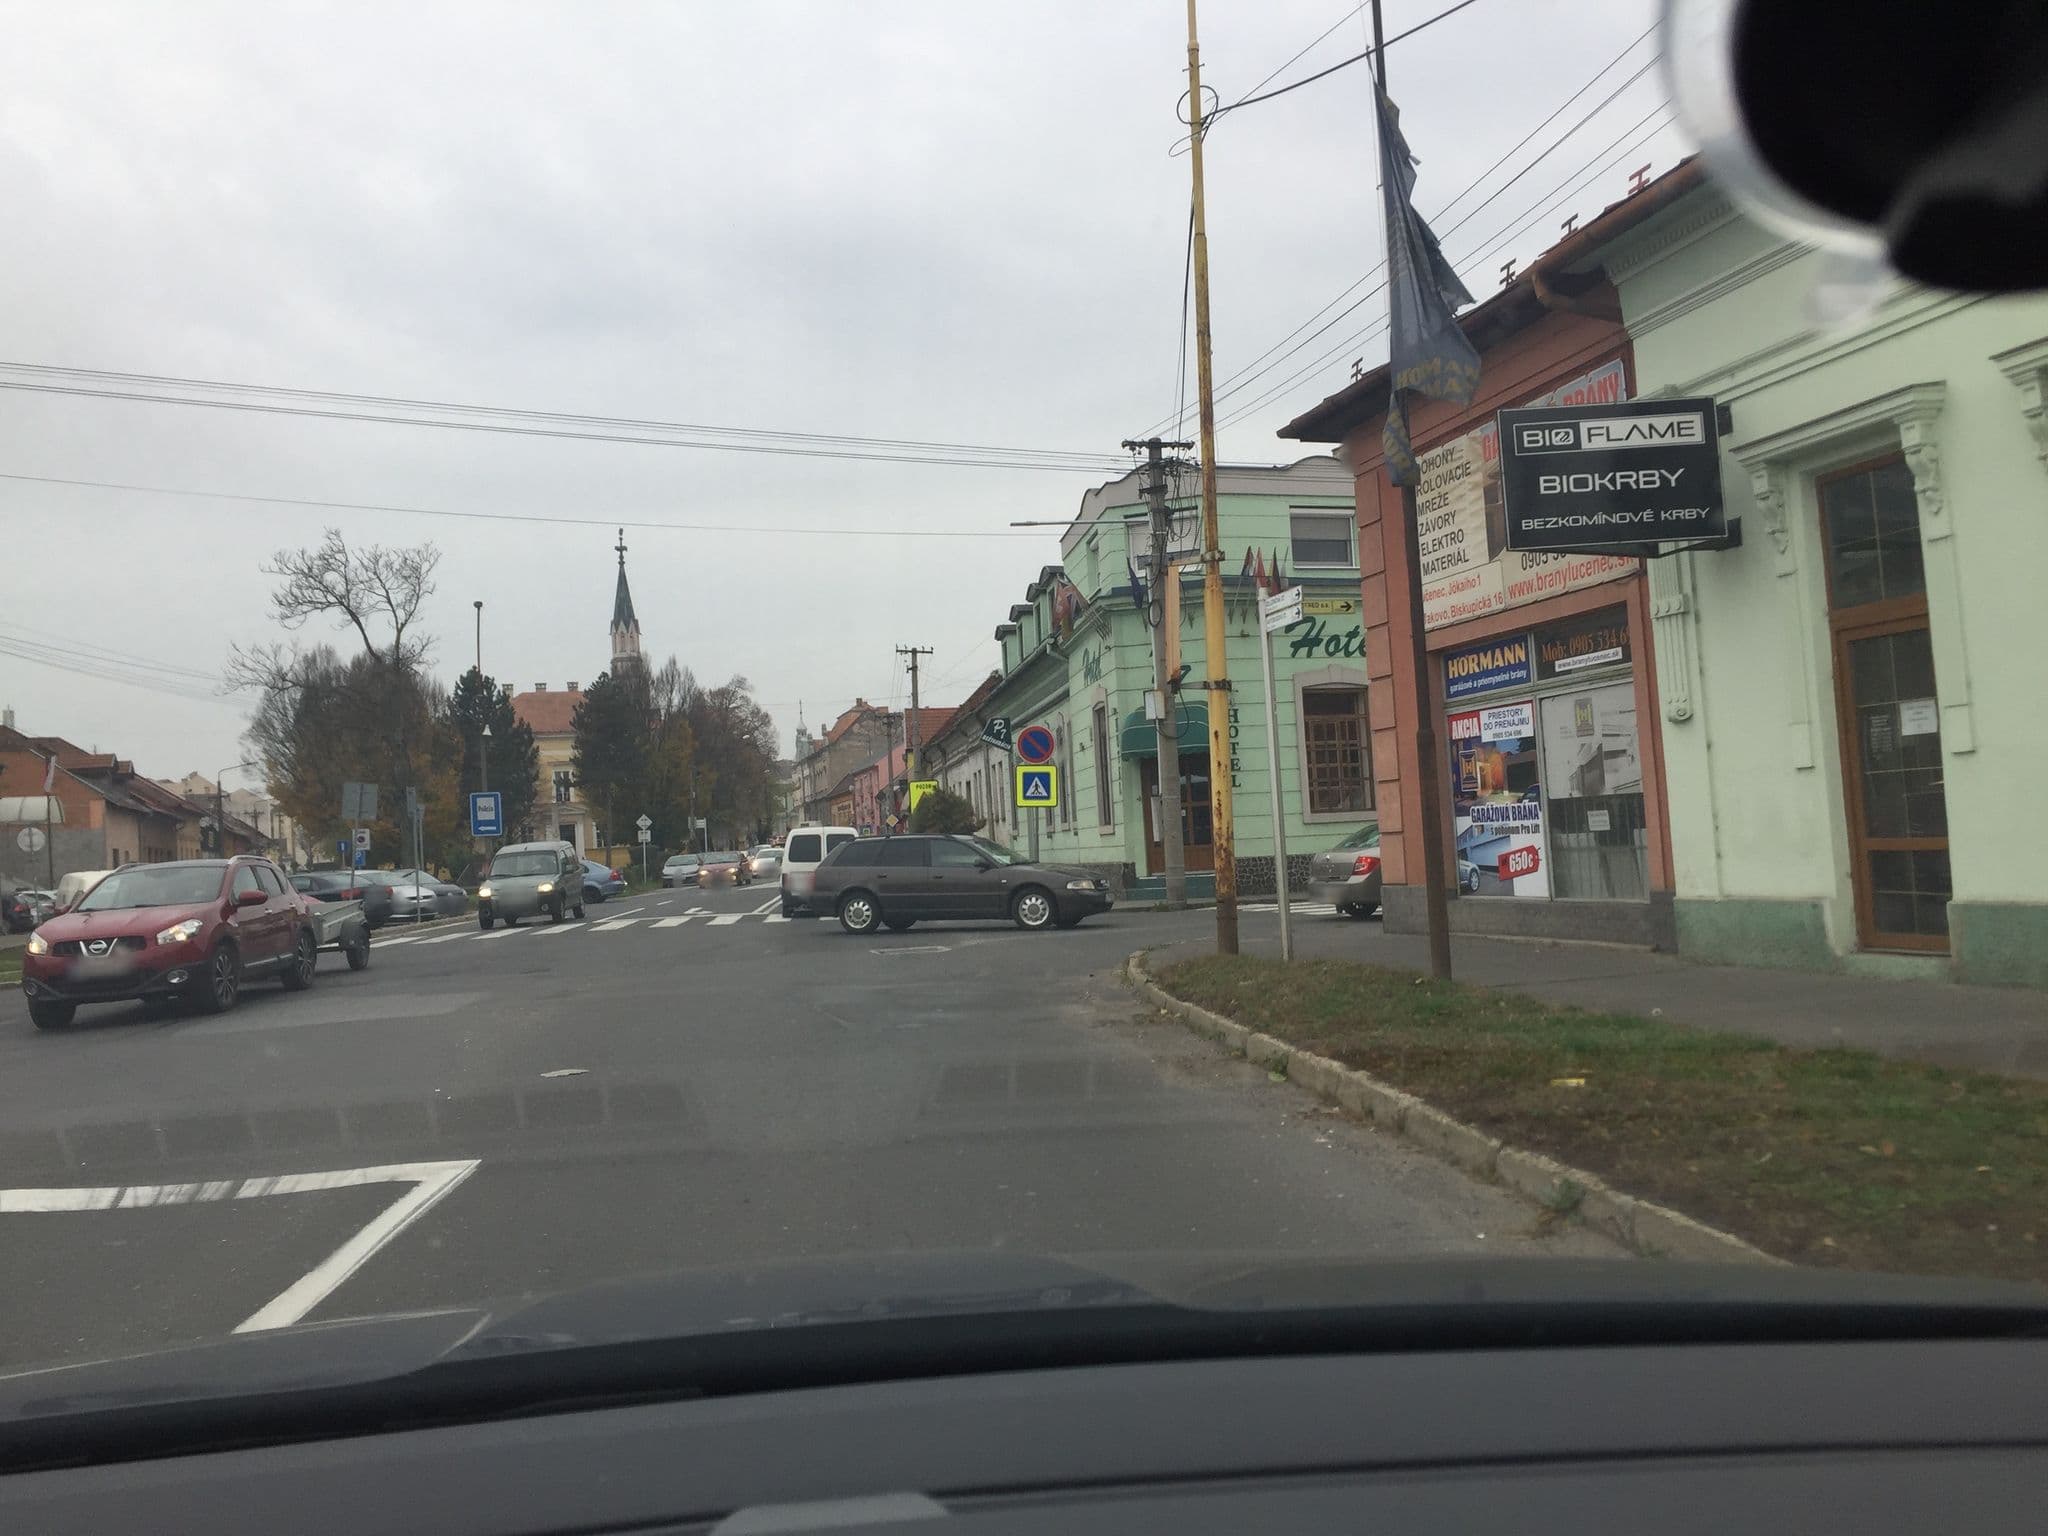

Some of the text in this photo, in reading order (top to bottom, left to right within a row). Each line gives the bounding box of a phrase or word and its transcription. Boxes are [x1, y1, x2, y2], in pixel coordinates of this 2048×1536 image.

[1523, 420, 1696, 448] BIO FLAME
[1421, 447, 1456, 475] OHONY
[1539, 467, 1686, 495] BIOKRBY
[1417, 491, 1450, 517] MREŽE
[1418, 510, 1457, 537] ZÁVORY
[1521, 507, 1711, 530] BEZKOMÍNOVÉ KRBY
[1421, 529, 1465, 557] ELEKTRO
[1422, 548, 1470, 577] MATERIÁL
[1493, 591, 1504, 606] 16
[1483, 722, 1493, 731] DO
[1488, 708, 1523, 721] PRIESTORY
[1452, 717, 1480, 740] AKCIA
[1228, 708, 1242, 788] HOTEL
[1471, 801, 1539, 823] GARÁŽOVÁ BRÁNA
